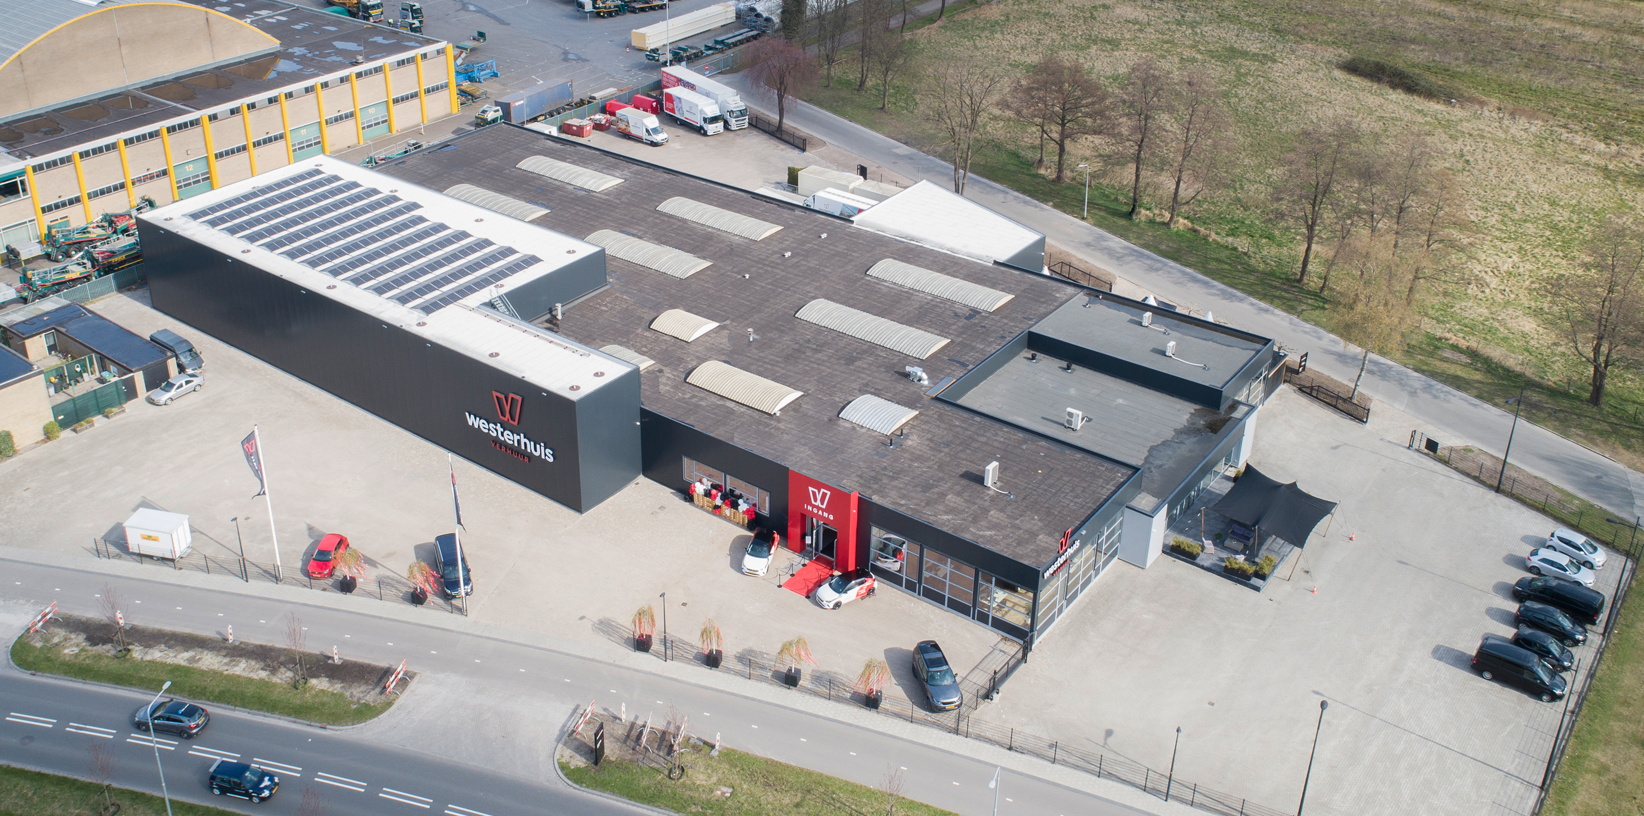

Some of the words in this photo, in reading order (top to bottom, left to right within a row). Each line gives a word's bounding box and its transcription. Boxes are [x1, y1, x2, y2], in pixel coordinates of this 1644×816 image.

[185, 164, 194, 172] 12
[465, 411, 554, 463] westerhuis
[490, 440, 531, 464] VERHUUR
[804, 503, 834, 520] INGANG
